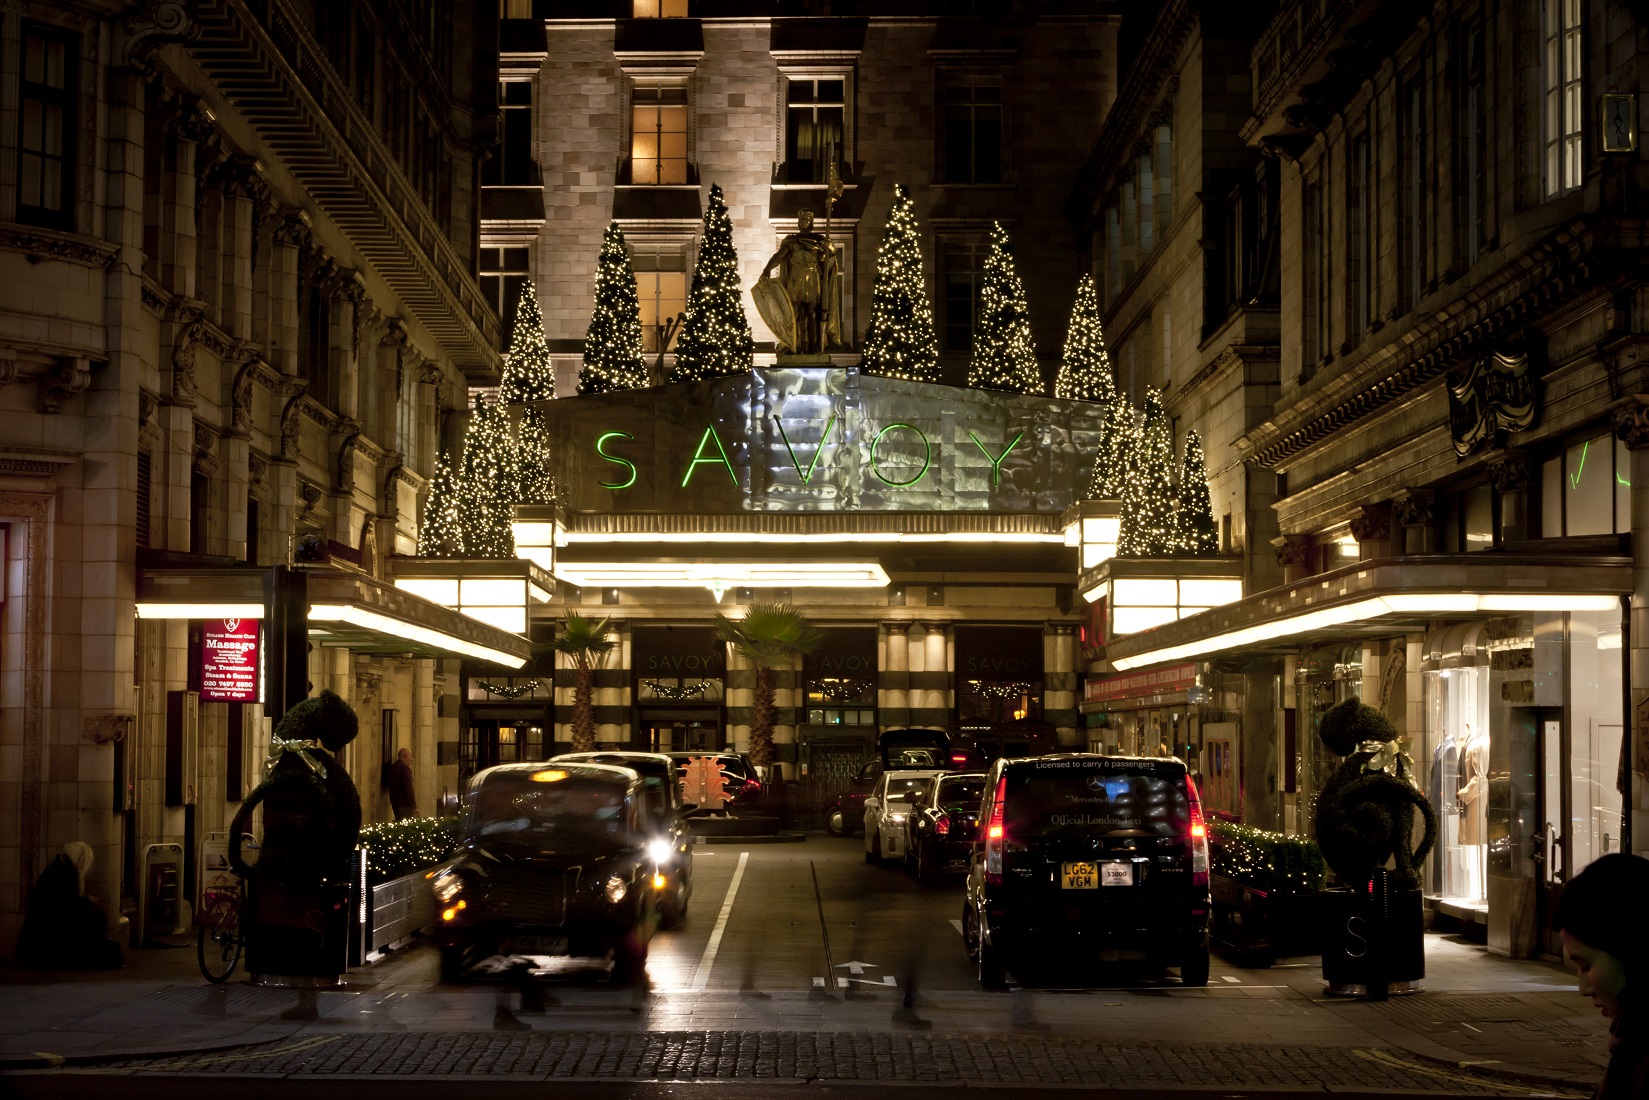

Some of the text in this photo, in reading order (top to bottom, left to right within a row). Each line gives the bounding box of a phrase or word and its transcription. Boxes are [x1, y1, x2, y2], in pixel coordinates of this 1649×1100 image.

[1614, 100, 1623, 146] TAXI
[596, 414, 1024, 489] SAVOY
[206, 639, 256, 652] Massage
[648, 655, 711, 670] SAVOY
[809, 655, 872, 671] SAVOY
[968, 656, 1032, 672] SAVOY
[1036, 761, 1071, 769] Licensed
[1082, 761, 1102, 769] carry
[1104, 760, 1109, 768] 6
[1111, 760, 1155, 770] passengers
[1051, 814, 1142, 825] Official London Taxi
[1064, 864, 1095, 875] LG62
[1069, 876, 1091, 887] VGM
[304, 909, 325, 951] S
[1346, 916, 1368, 958] S
